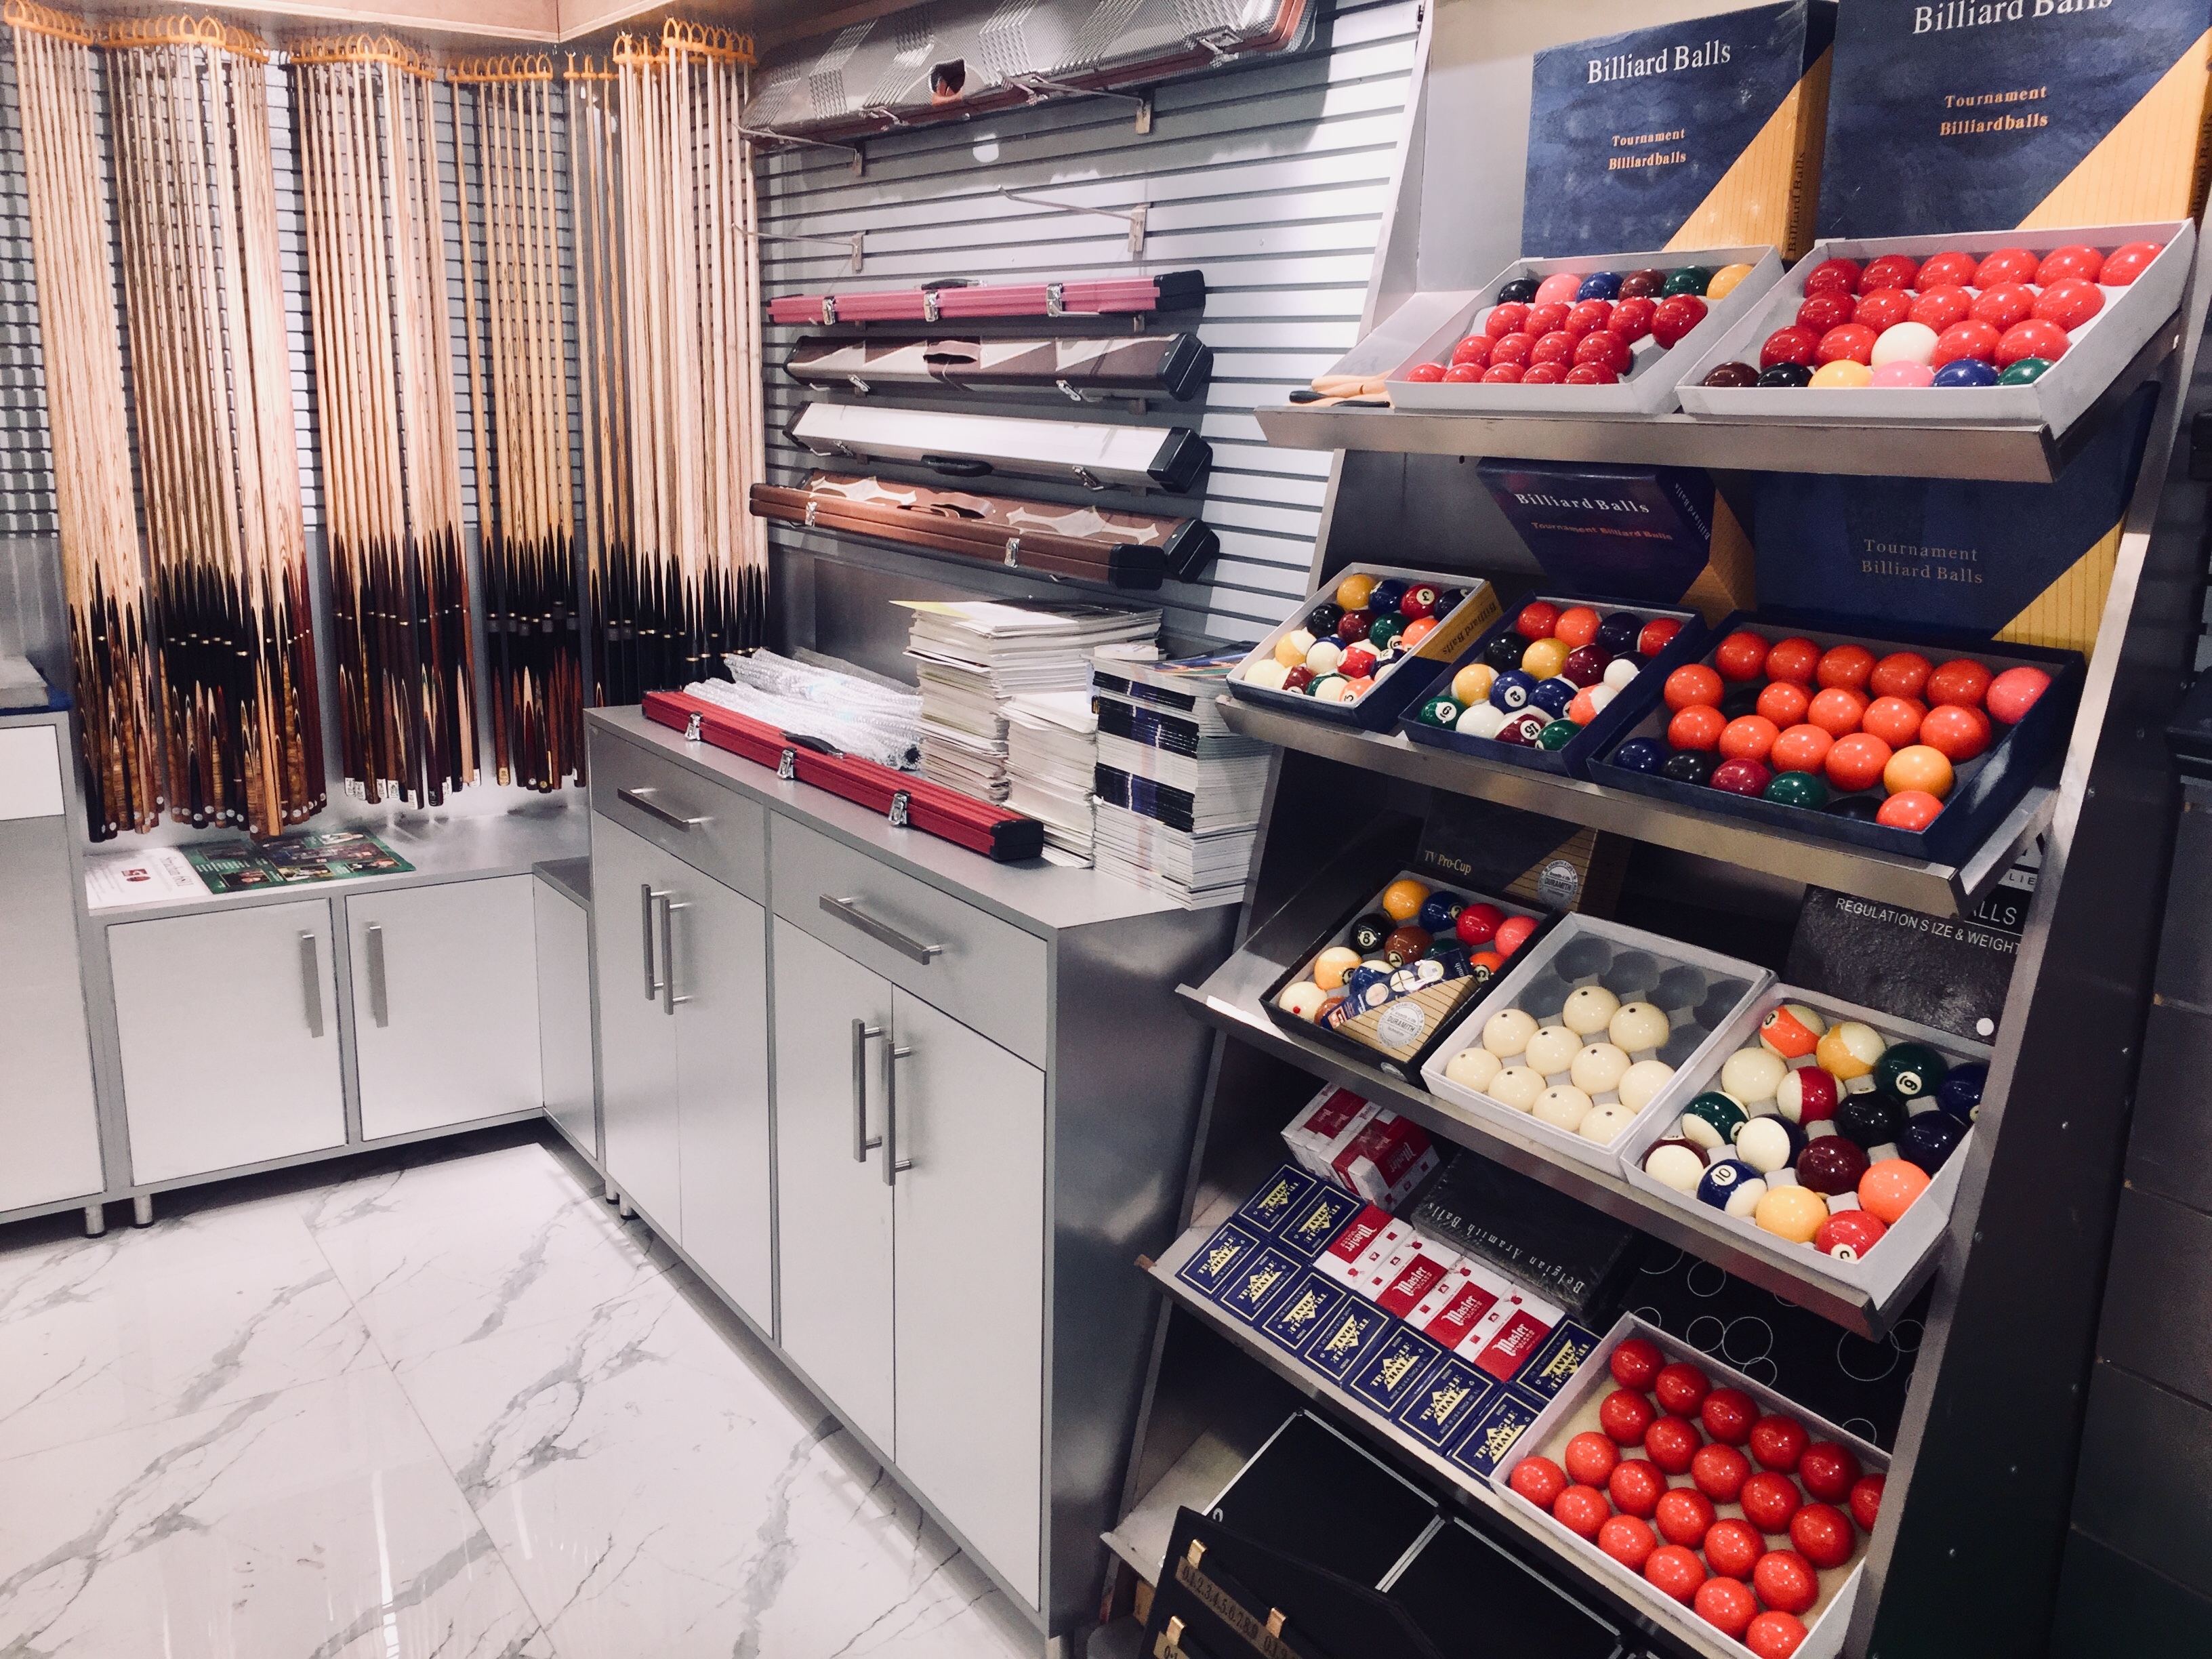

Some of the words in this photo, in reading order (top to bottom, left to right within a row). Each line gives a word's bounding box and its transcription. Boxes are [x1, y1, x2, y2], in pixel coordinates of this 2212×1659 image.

[1912, 0, 2023, 34] Billiard
[1587, 48, 1668, 84] Billiard
[1673, 39, 1731, 70] Balls
[1944, 86, 2047, 108] Tournament
[1612, 128, 1685, 146] Tournament
[1940, 112, 2048, 136] Billiardballs
[1608, 151, 1686, 170] Billiardballs
[1794, 152, 1805, 187] Balls
[1788, 196, 1801, 251] Billiard
[1514, 493, 1593, 509] Billiard
[1595, 499, 1650, 513] Balls
[1531, 522, 1598, 533] Tournament
[1599, 527, 1641, 537] Billiard
[1864, 539, 1978, 562] Tournament
[1862, 560, 1931, 579] Billiard
[1937, 567, 1983, 583] Balls
[1465, 602, 1497, 633] Billiard
[1443, 632, 1466, 655] Balls
[1524, 722, 1539, 737] 15
[1425, 850, 1437, 863] TV
[1437, 854, 1471, 876] Pro-Cup
[1363, 933, 1370, 944] 8
[1836, 897, 1918, 929] REGULATION
[1920, 919, 1952, 938] SIZE
[1955, 928, 1963, 941] &
[1968, 930, 2020, 955] WEIGHT
[1387, 1015, 1415, 1033] DURAMITH
[1716, 1168, 1731, 1182] 10
[1303, 1203, 1342, 1244] TRIANGLE
[1428, 1202, 1462, 1228] Balls
[1345, 1223, 1376, 1251] Master
[1467, 1223, 1523, 1259] Aramith
[1196, 1235, 1236, 1275] TRIANGLE
[1208, 1245, 1235, 1273] CHALK
[1236, 1259, 1277, 1300] TRIANGLE
[1248, 1269, 1277, 1298] CHALK
[1392, 1266, 1427, 1296] Master
[1530, 1256, 1585, 1294] Belgian
[1286, 1294, 1316, 1324] CHALK
[1286, 1292, 1328, 1334] TRIANGLE
[1441, 1295, 1476, 1326] Master
[1329, 1319, 1359, 1352] CHALK
[1330, 1317, 1370, 1364] TRIANGLE
[1492, 1323, 1528, 1356] Master
[1369, 1341, 1412, 1388] TRIANGLE
[1382, 1353, 1413, 1386] CHALK
[1545, 1345, 1578, 1378] CHALK
[1546, 1341, 1593, 1391] TRIANGLE
[1418, 1374, 1463, 1422] TRIANGLE
[1432, 1386, 1464, 1420] CHALK
[1473, 1410, 1518, 1460] TRIANGLE
[1487, 1422, 1519, 1457] CHALK
